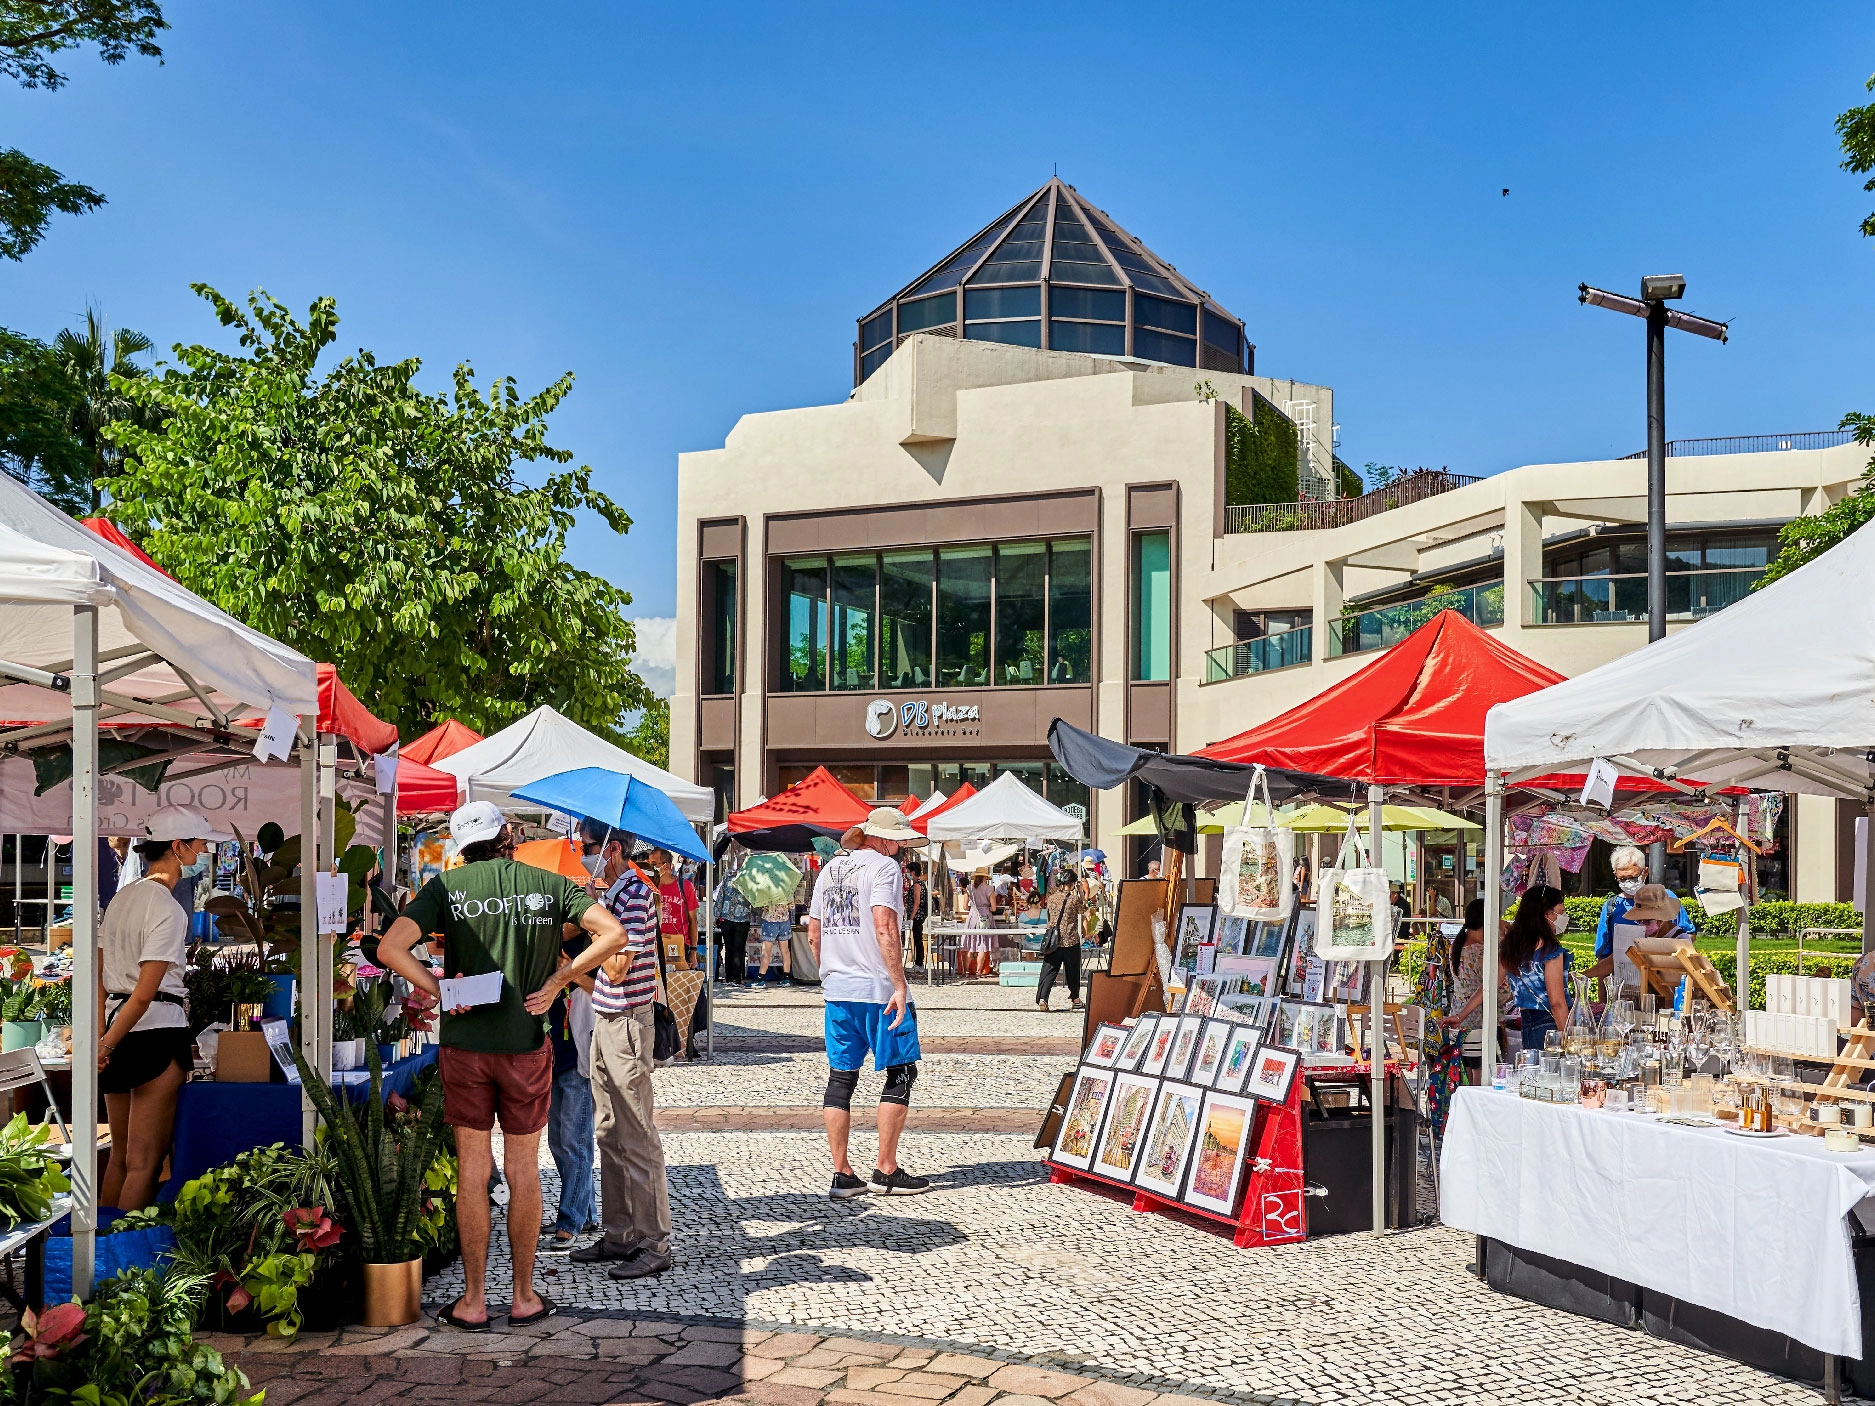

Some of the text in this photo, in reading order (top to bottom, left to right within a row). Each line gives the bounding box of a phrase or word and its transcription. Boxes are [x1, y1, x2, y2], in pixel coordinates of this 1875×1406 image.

[901, 700, 928, 727] DB
[448, 890, 467, 902] My
[451, 893, 554, 921] ROOFTOP
[511, 913, 553, 926] is Green
